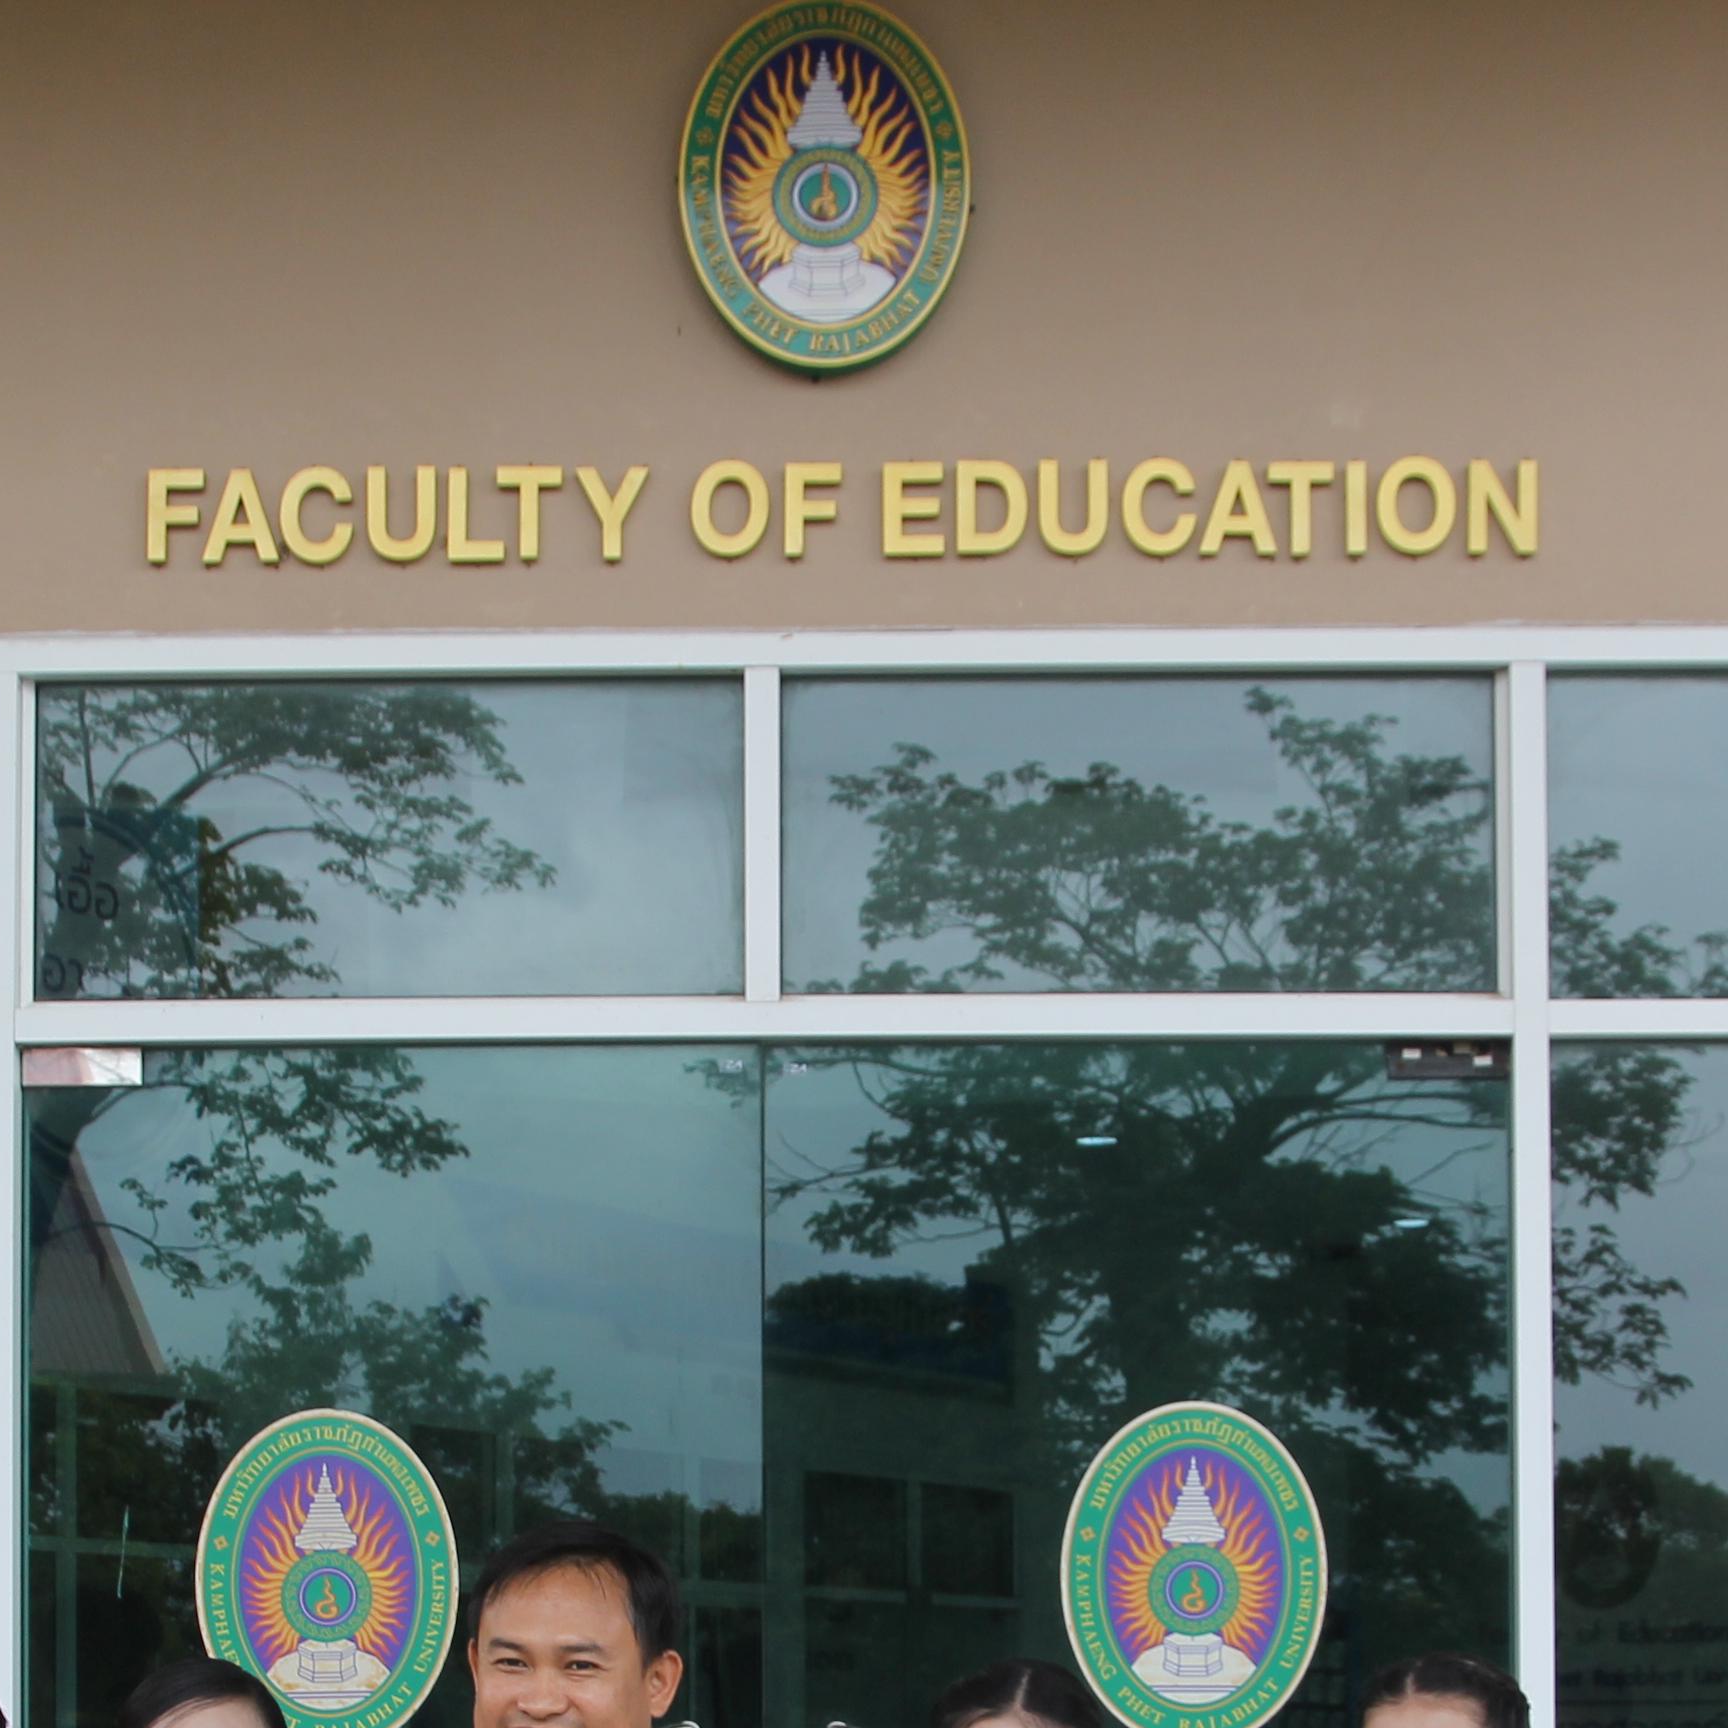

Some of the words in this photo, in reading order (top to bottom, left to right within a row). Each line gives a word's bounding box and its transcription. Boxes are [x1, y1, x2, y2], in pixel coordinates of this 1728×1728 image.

[690, 154, 741, 299] KAMPHAENG
[742, 301, 801, 345] PHET
[809, 289, 922, 354] RAJABHAT
[920, 150, 961, 283] UNIVERSITY
[147, 464, 650, 565] FACULTY
[689, 458, 843, 560] OF
[881, 454, 1538, 558] EDUCATION
[209, 1562, 241, 1666] KAMPHAE
[413, 1558, 445, 1674] UNIVERSITY
[1076, 1554, 1117, 1681] KAMPHAENG
[1117, 1686, 1166, 1726] PHET
[1279, 1554, 1314, 1671] UNIVERSITY
